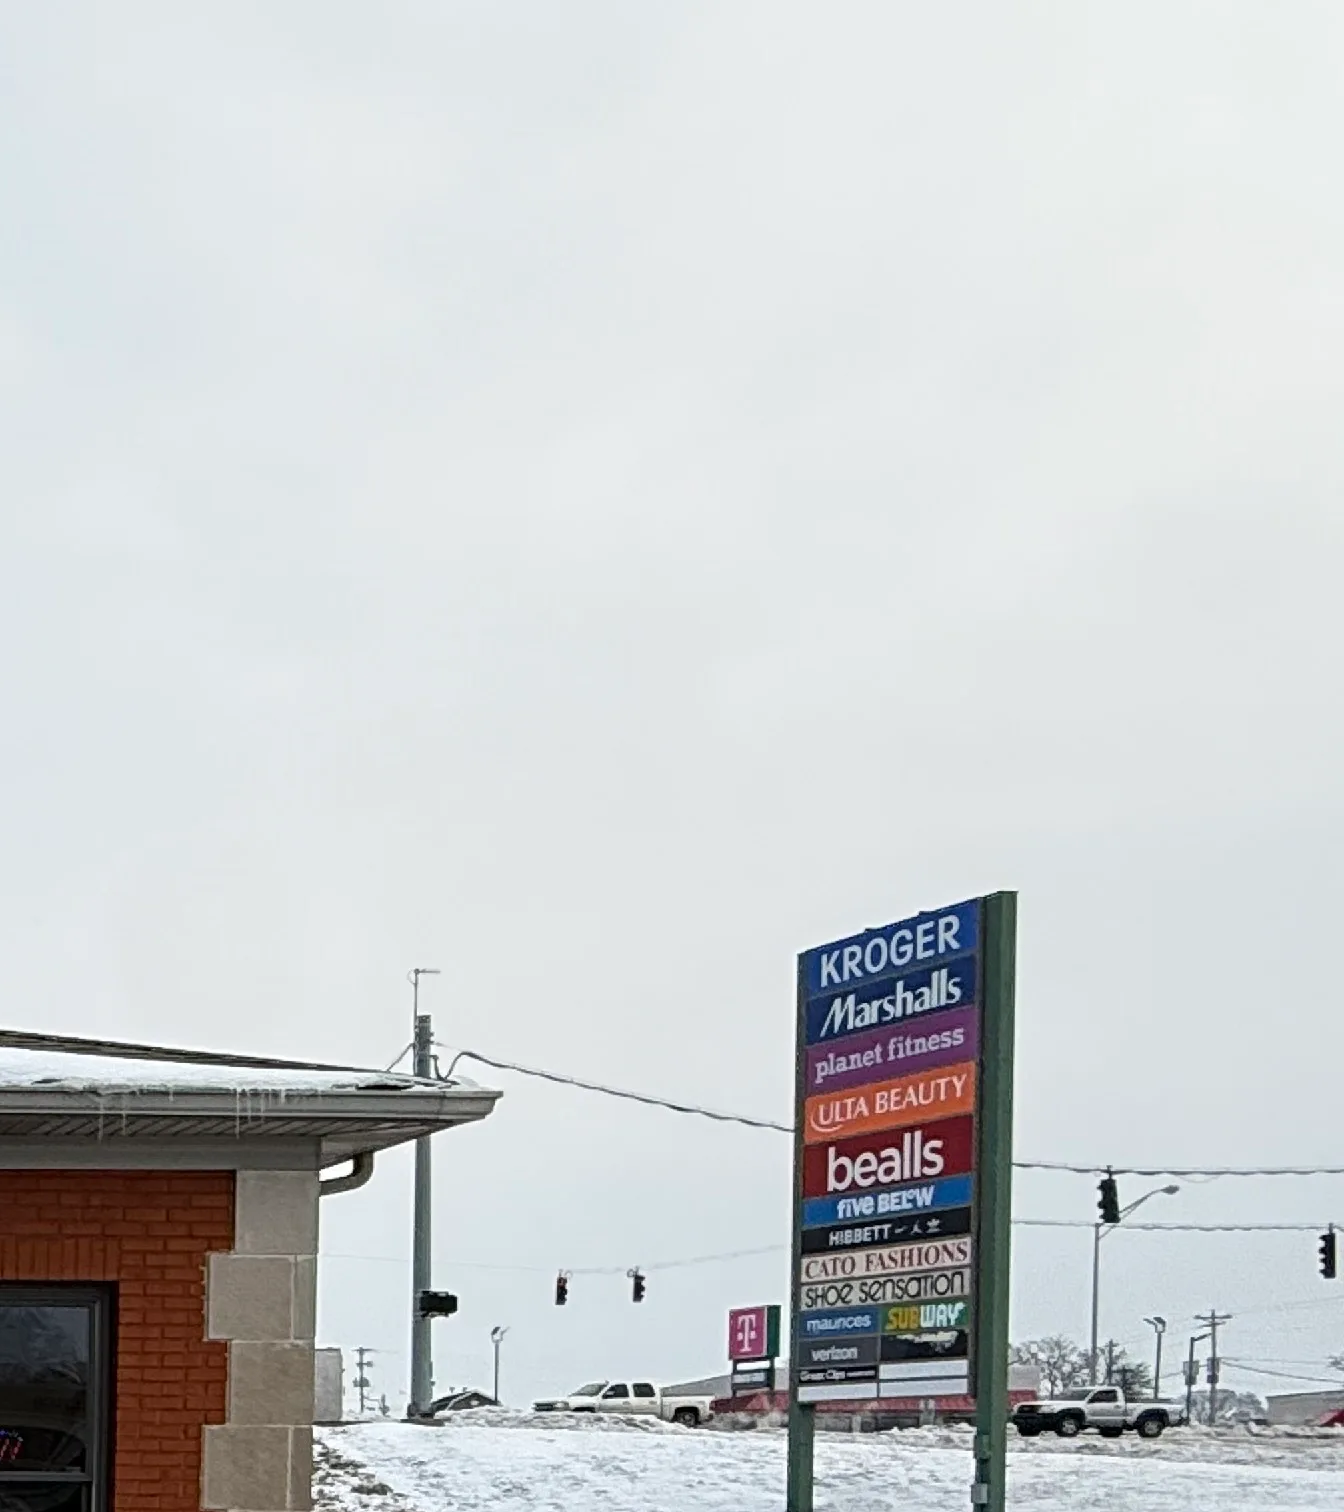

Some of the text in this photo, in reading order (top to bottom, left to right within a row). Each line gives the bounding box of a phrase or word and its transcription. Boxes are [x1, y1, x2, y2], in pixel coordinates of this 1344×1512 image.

[820, 914, 960, 988] KROGER
[820, 967, 962, 1038] Marshalls
[815, 1027, 964, 1085] planet fitness
[817, 1074, 967, 1127] ULTA BEAUTY
[827, 1130, 945, 1192] bealls
[877, 1185, 935, 1213] BELOW
[828, 1223, 892, 1246] HIBBETT
[805, 1241, 968, 1280] CATO FASHIONS
[806, 1314, 872, 1334] maurices
[885, 1302, 966, 1330] SUBWAY
[811, 1346, 858, 1362] verizon
